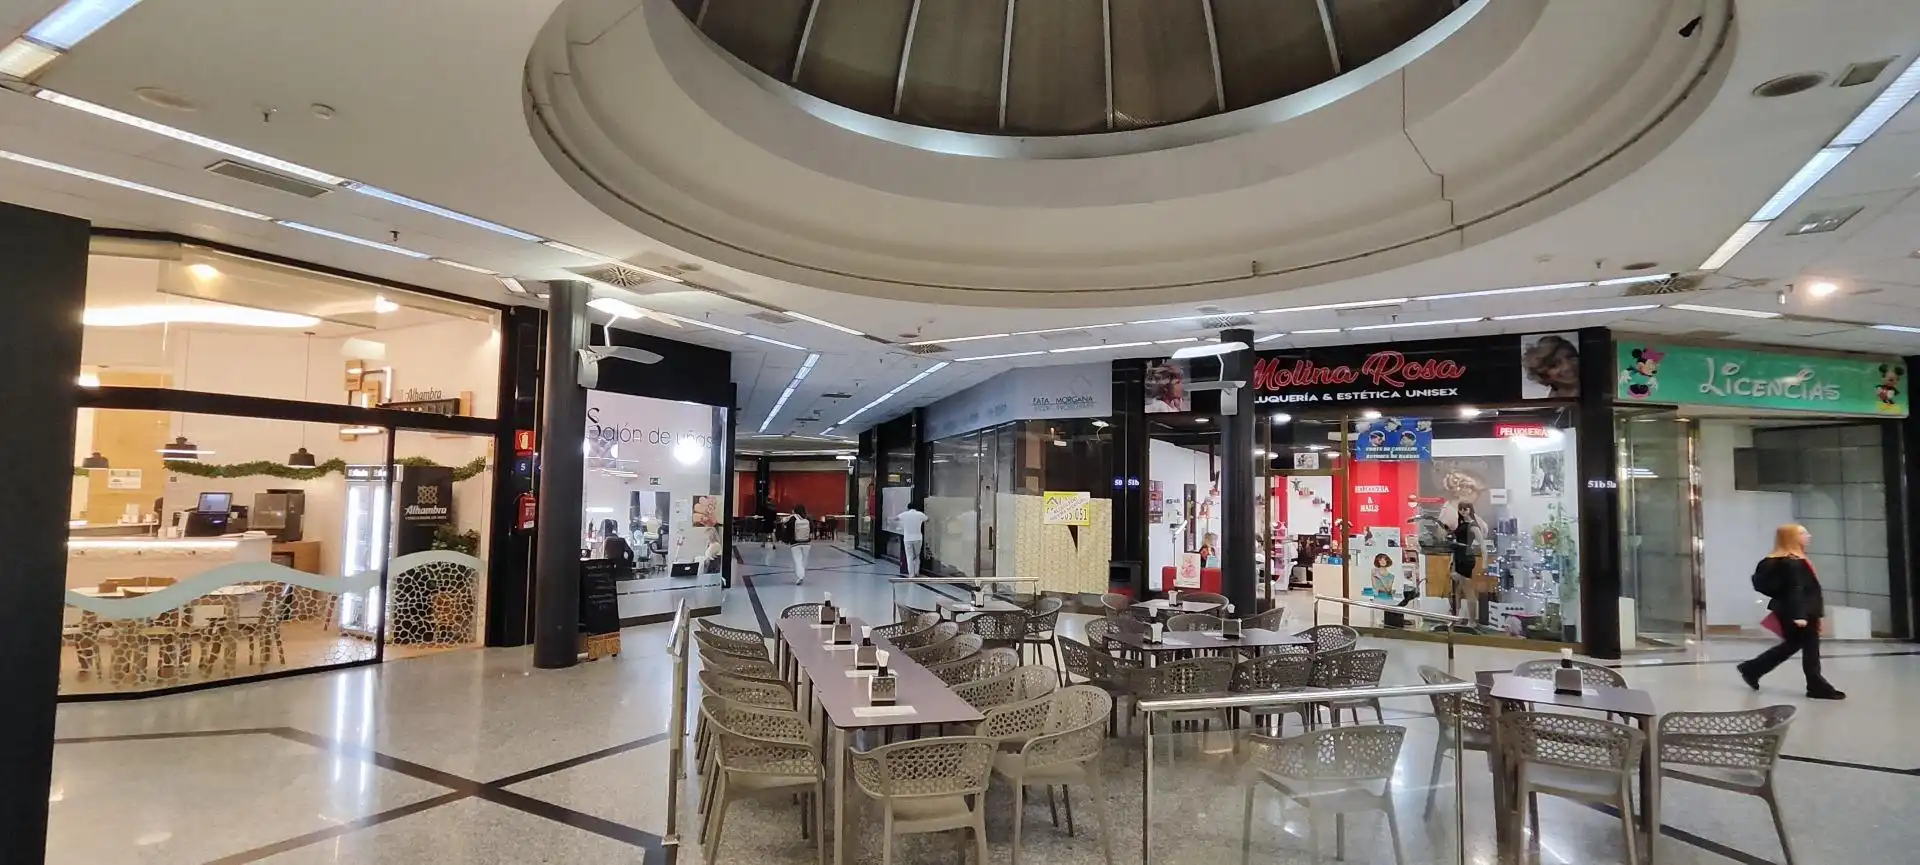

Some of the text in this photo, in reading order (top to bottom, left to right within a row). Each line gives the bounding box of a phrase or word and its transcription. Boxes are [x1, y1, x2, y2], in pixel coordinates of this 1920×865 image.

[1254, 350, 1466, 391] Molina Rosa
[1322, 393, 1333, 401] &
[1336, 389, 1401, 401] ESTÉTICA
[1405, 388, 1458, 398] UNISEX
[587, 407, 643, 443] Salón
[648, 427, 671, 444] de
[404, 505, 447, 515] Alhambra
